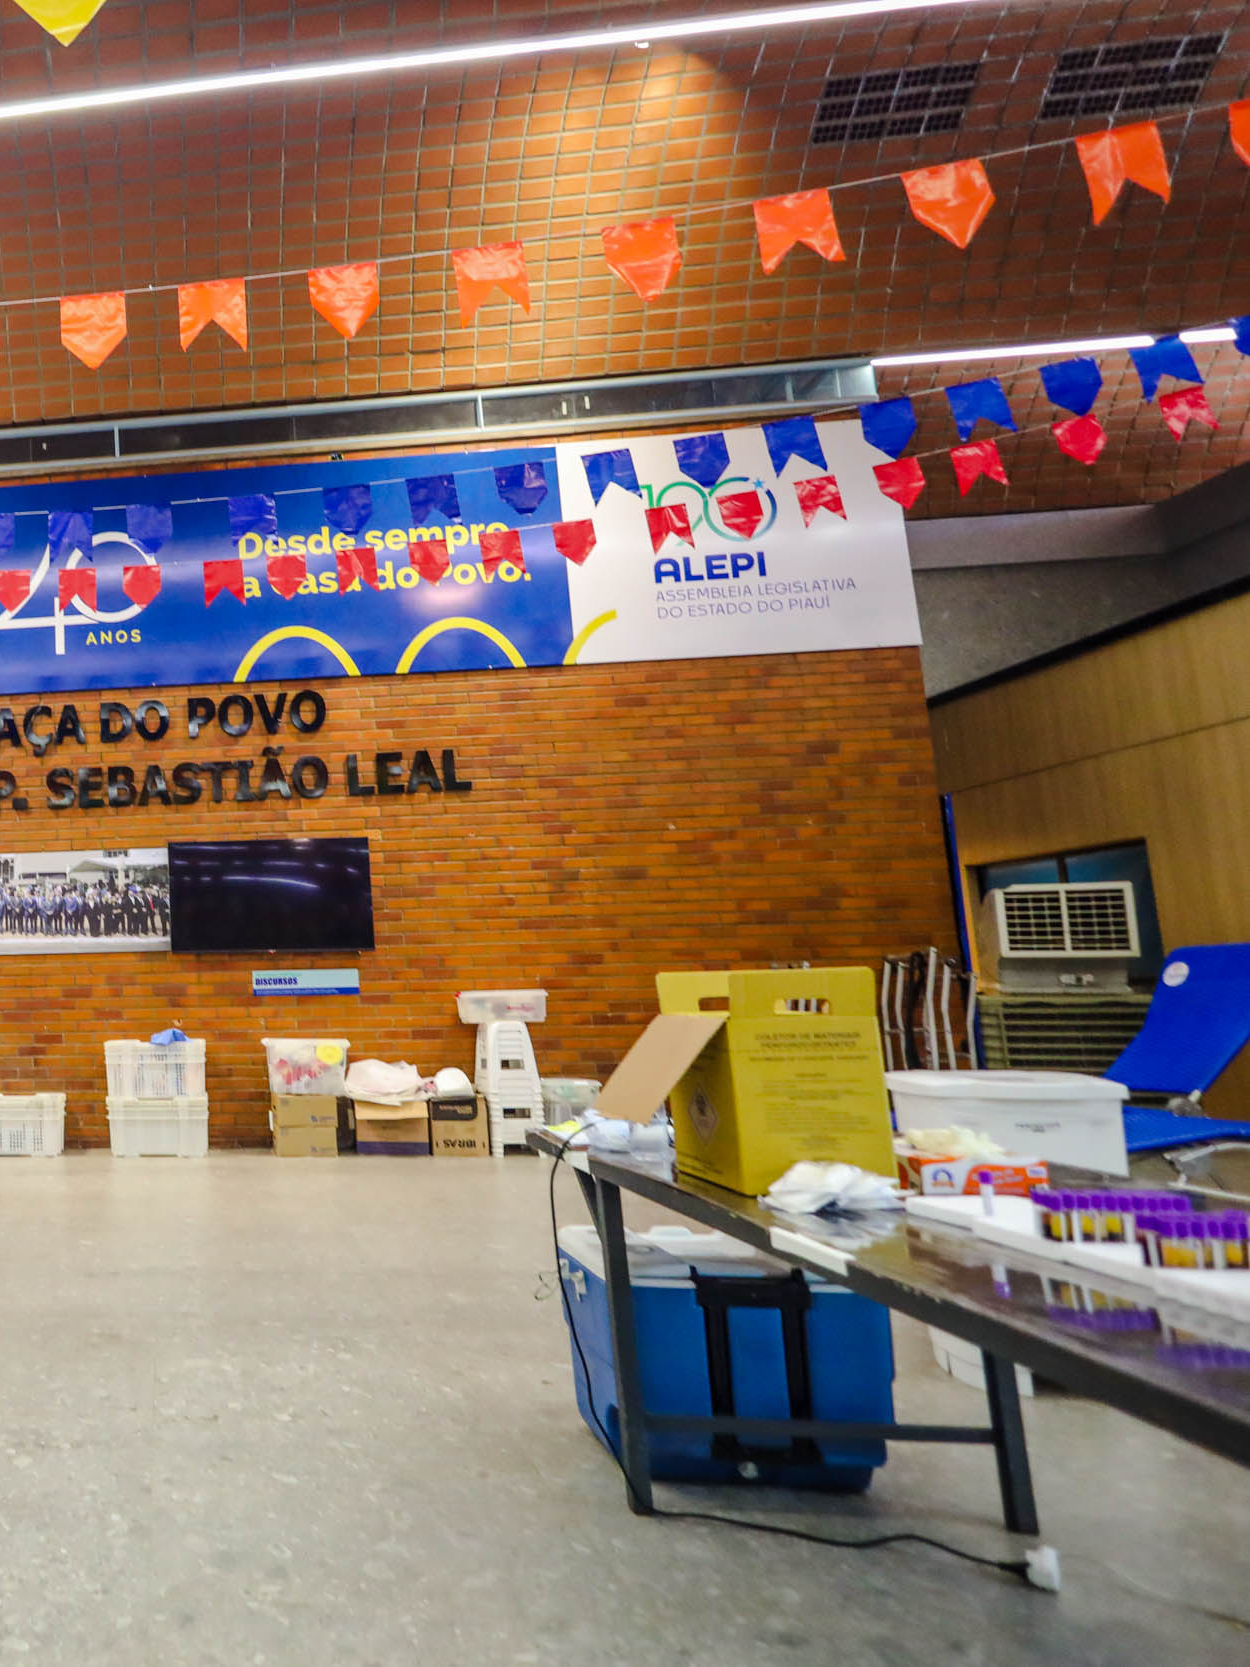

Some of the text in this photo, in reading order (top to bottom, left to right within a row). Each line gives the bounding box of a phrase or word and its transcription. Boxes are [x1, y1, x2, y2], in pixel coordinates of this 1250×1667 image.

[238, 526, 356, 560] Desde
[243, 576, 262, 598] a
[377, 560, 420, 591] do
[433, 560, 532, 587] ovo.
[654, 551, 767, 584] ALEPI
[656, 577, 857, 602] ASSEMBLEIA LEGISLATIVA
[657, 595, 831, 620] DO ESTADO DO PIAUÍ
[86, 628, 142, 646] ANOS
[100, 700, 171, 743] DO
[187, 689, 327, 739] POVO
[46, 746, 329, 808] SEBASTIÃO
[347, 749, 473, 798] LEAL
[255, 976, 298, 986] DISCURSOS
